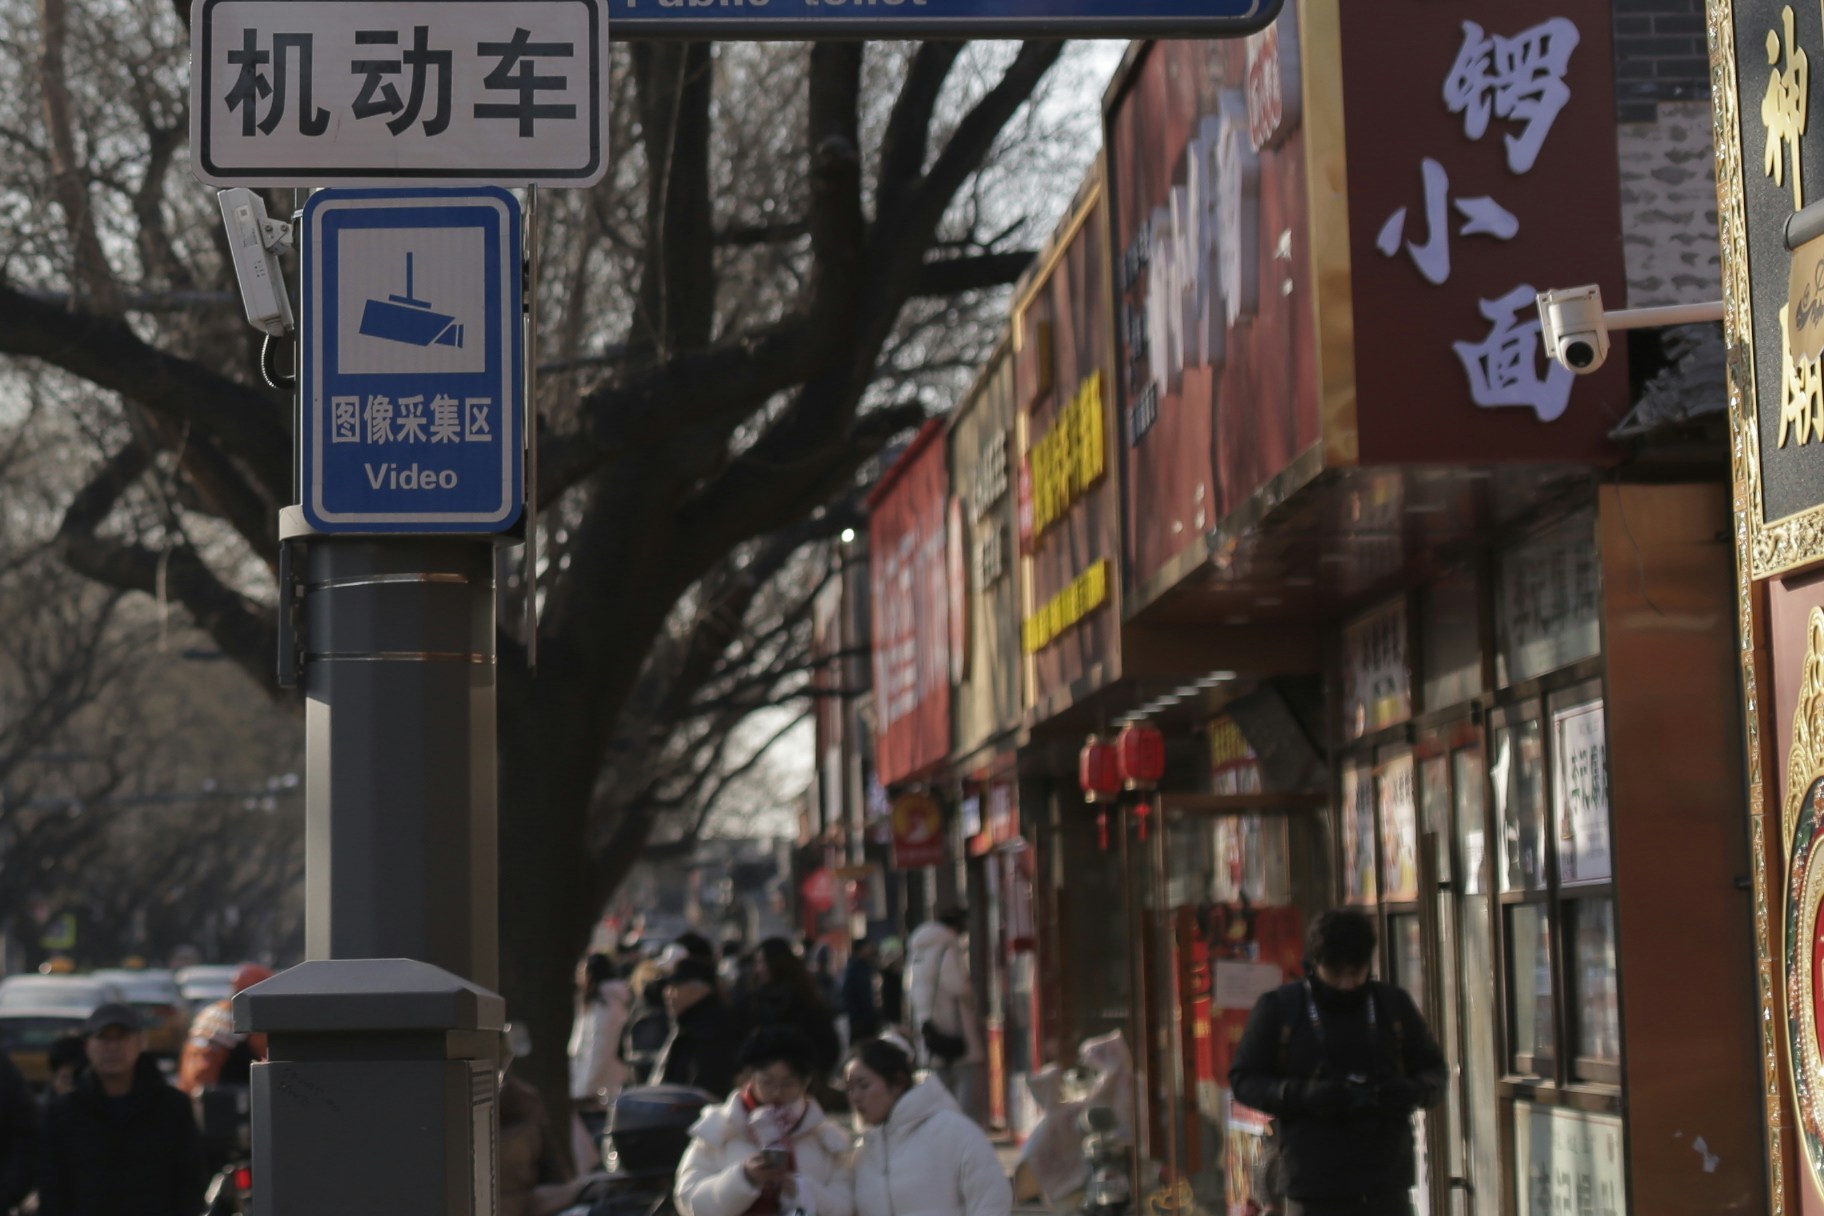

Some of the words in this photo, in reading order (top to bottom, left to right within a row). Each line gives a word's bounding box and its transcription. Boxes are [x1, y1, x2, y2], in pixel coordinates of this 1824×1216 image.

[224, 25, 577, 138] 机动车
[331, 393, 493, 445] 图像采集区
[364, 462, 459, 491] Video
